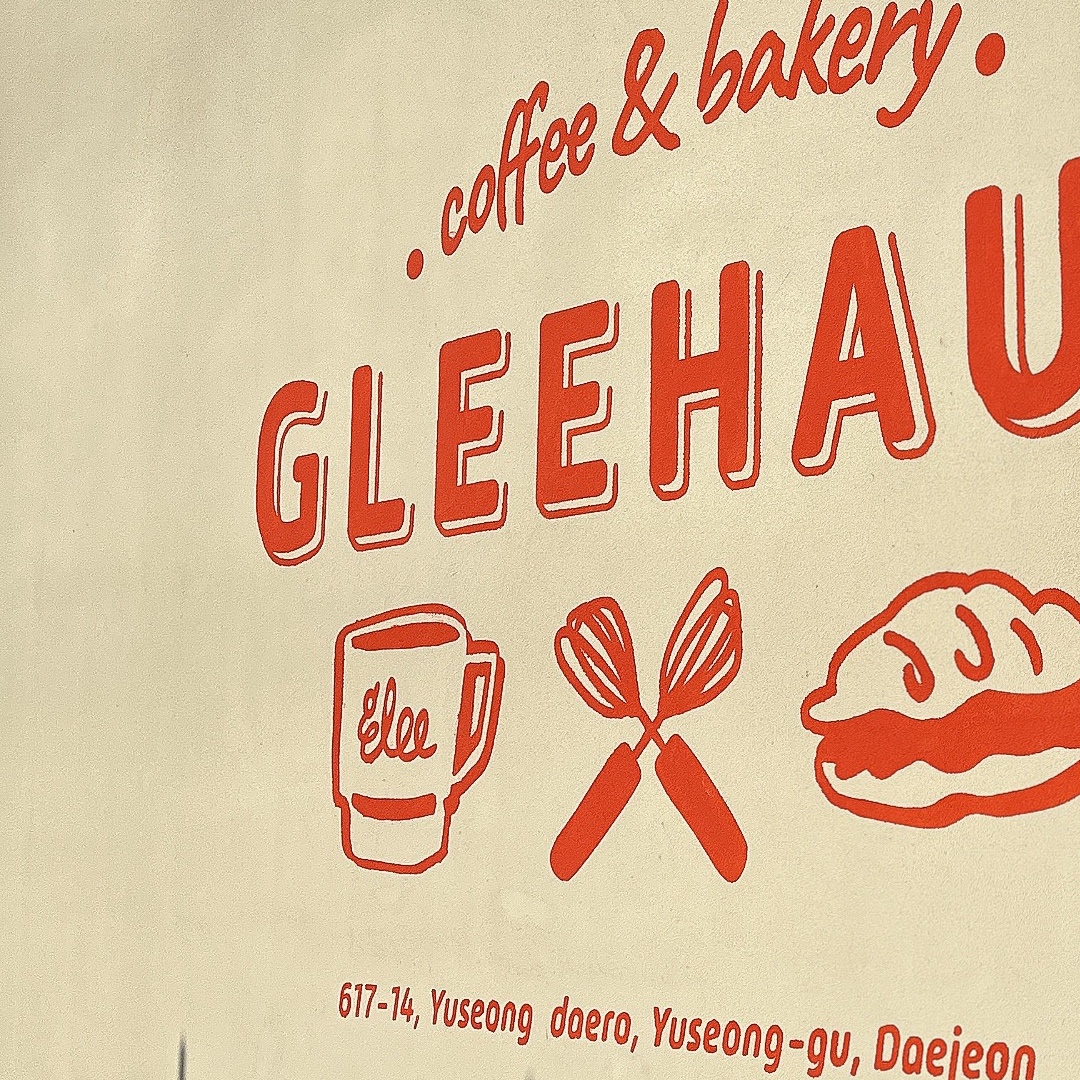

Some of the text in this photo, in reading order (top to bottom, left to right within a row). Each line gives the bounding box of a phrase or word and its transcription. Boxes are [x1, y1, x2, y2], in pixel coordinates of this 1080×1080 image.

[441, 0, 963, 256] coffee & bakery
[338, 981, 421, 1030] 617-14,
[431, 988, 533, 1046] Yuseong
[550, 995, 639, 1053] daero,
[653, 1006, 860, 1078] Yuseong-gu,
